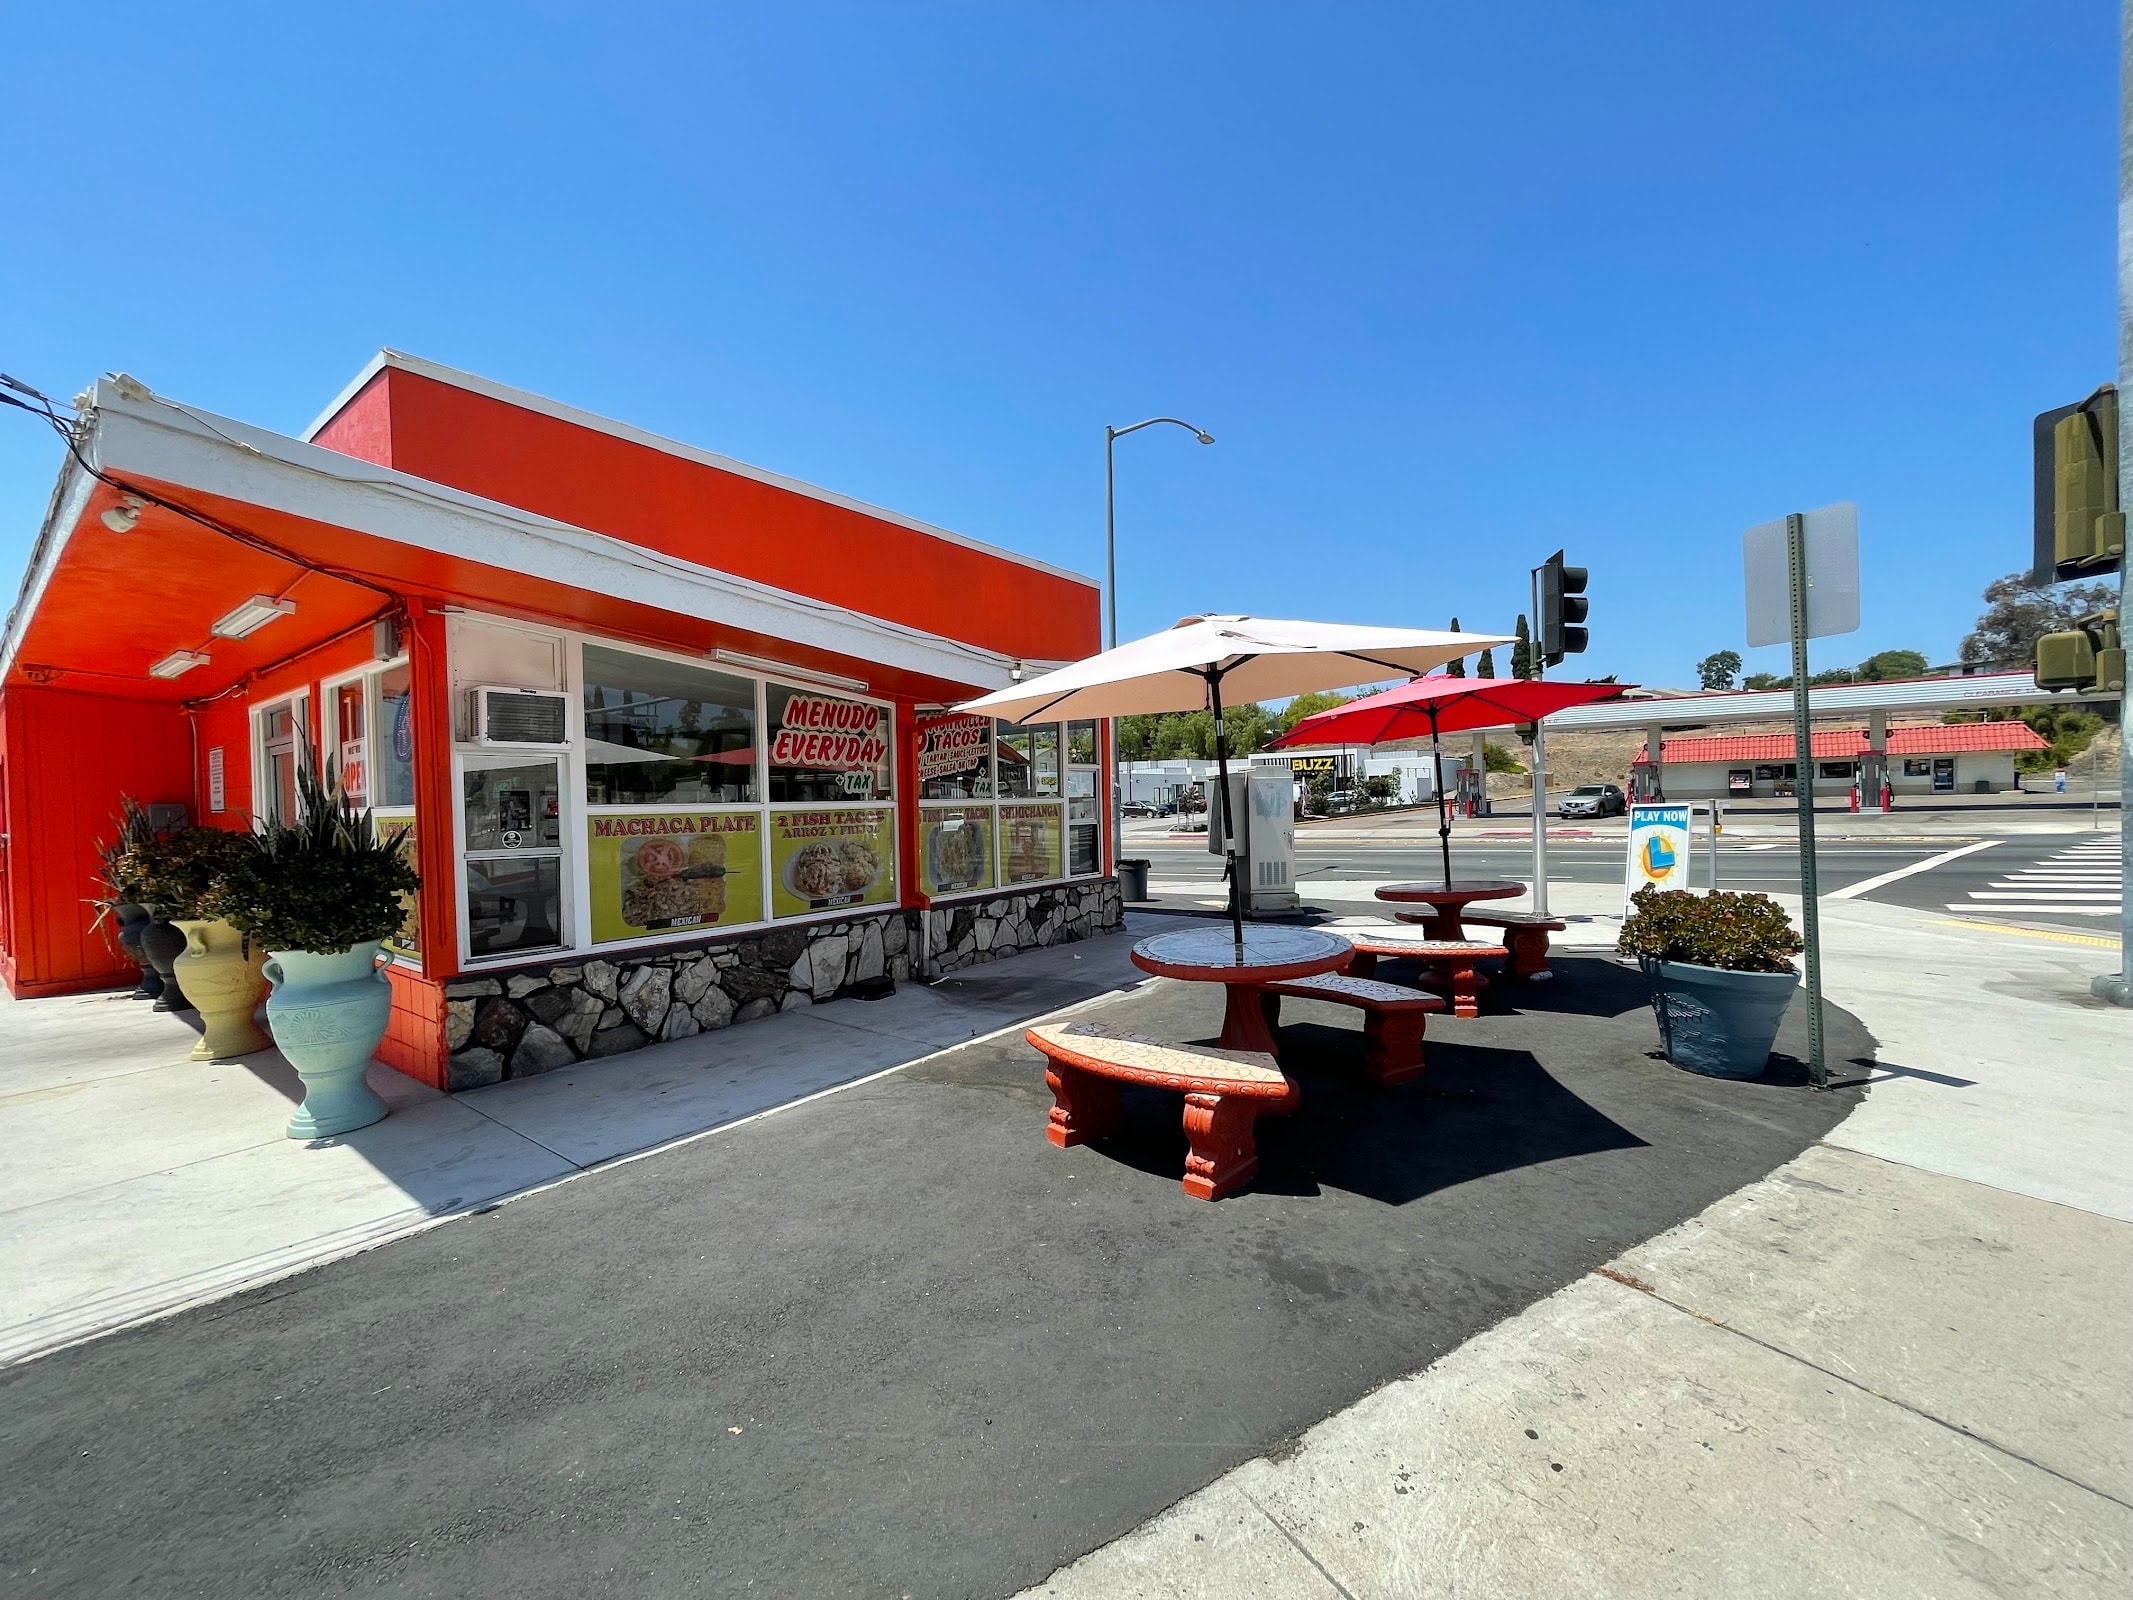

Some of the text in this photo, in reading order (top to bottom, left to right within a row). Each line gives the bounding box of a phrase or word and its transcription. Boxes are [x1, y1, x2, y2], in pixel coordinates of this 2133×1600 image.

[785, 698, 879, 732] MENUDO
[934, 728, 980, 751] TACOS
[775, 732, 886, 763] EVERYDAY
[926, 752, 948, 764] TARTAR
[967, 757, 978, 768] TOP
[1291, 757, 1335, 771] BUZZ
[846, 774, 871, 791] TAX
[974, 781, 991, 793] TAX
[964, 806, 990, 820] TACOS
[1000, 804, 1059, 819] CHIMICHANGA
[1633, 810, 1688, 823] PLAY NOW
[594, 815, 756, 837] MACHACA PLATE
[778, 810, 886, 828] 2 FISH TACOS
[781, 826, 828, 839] ARROZ
[829, 825, 838, 836] Y
[826, 896, 851, 907] MEXICAN
[670, 914, 702, 927] MEXICAN
